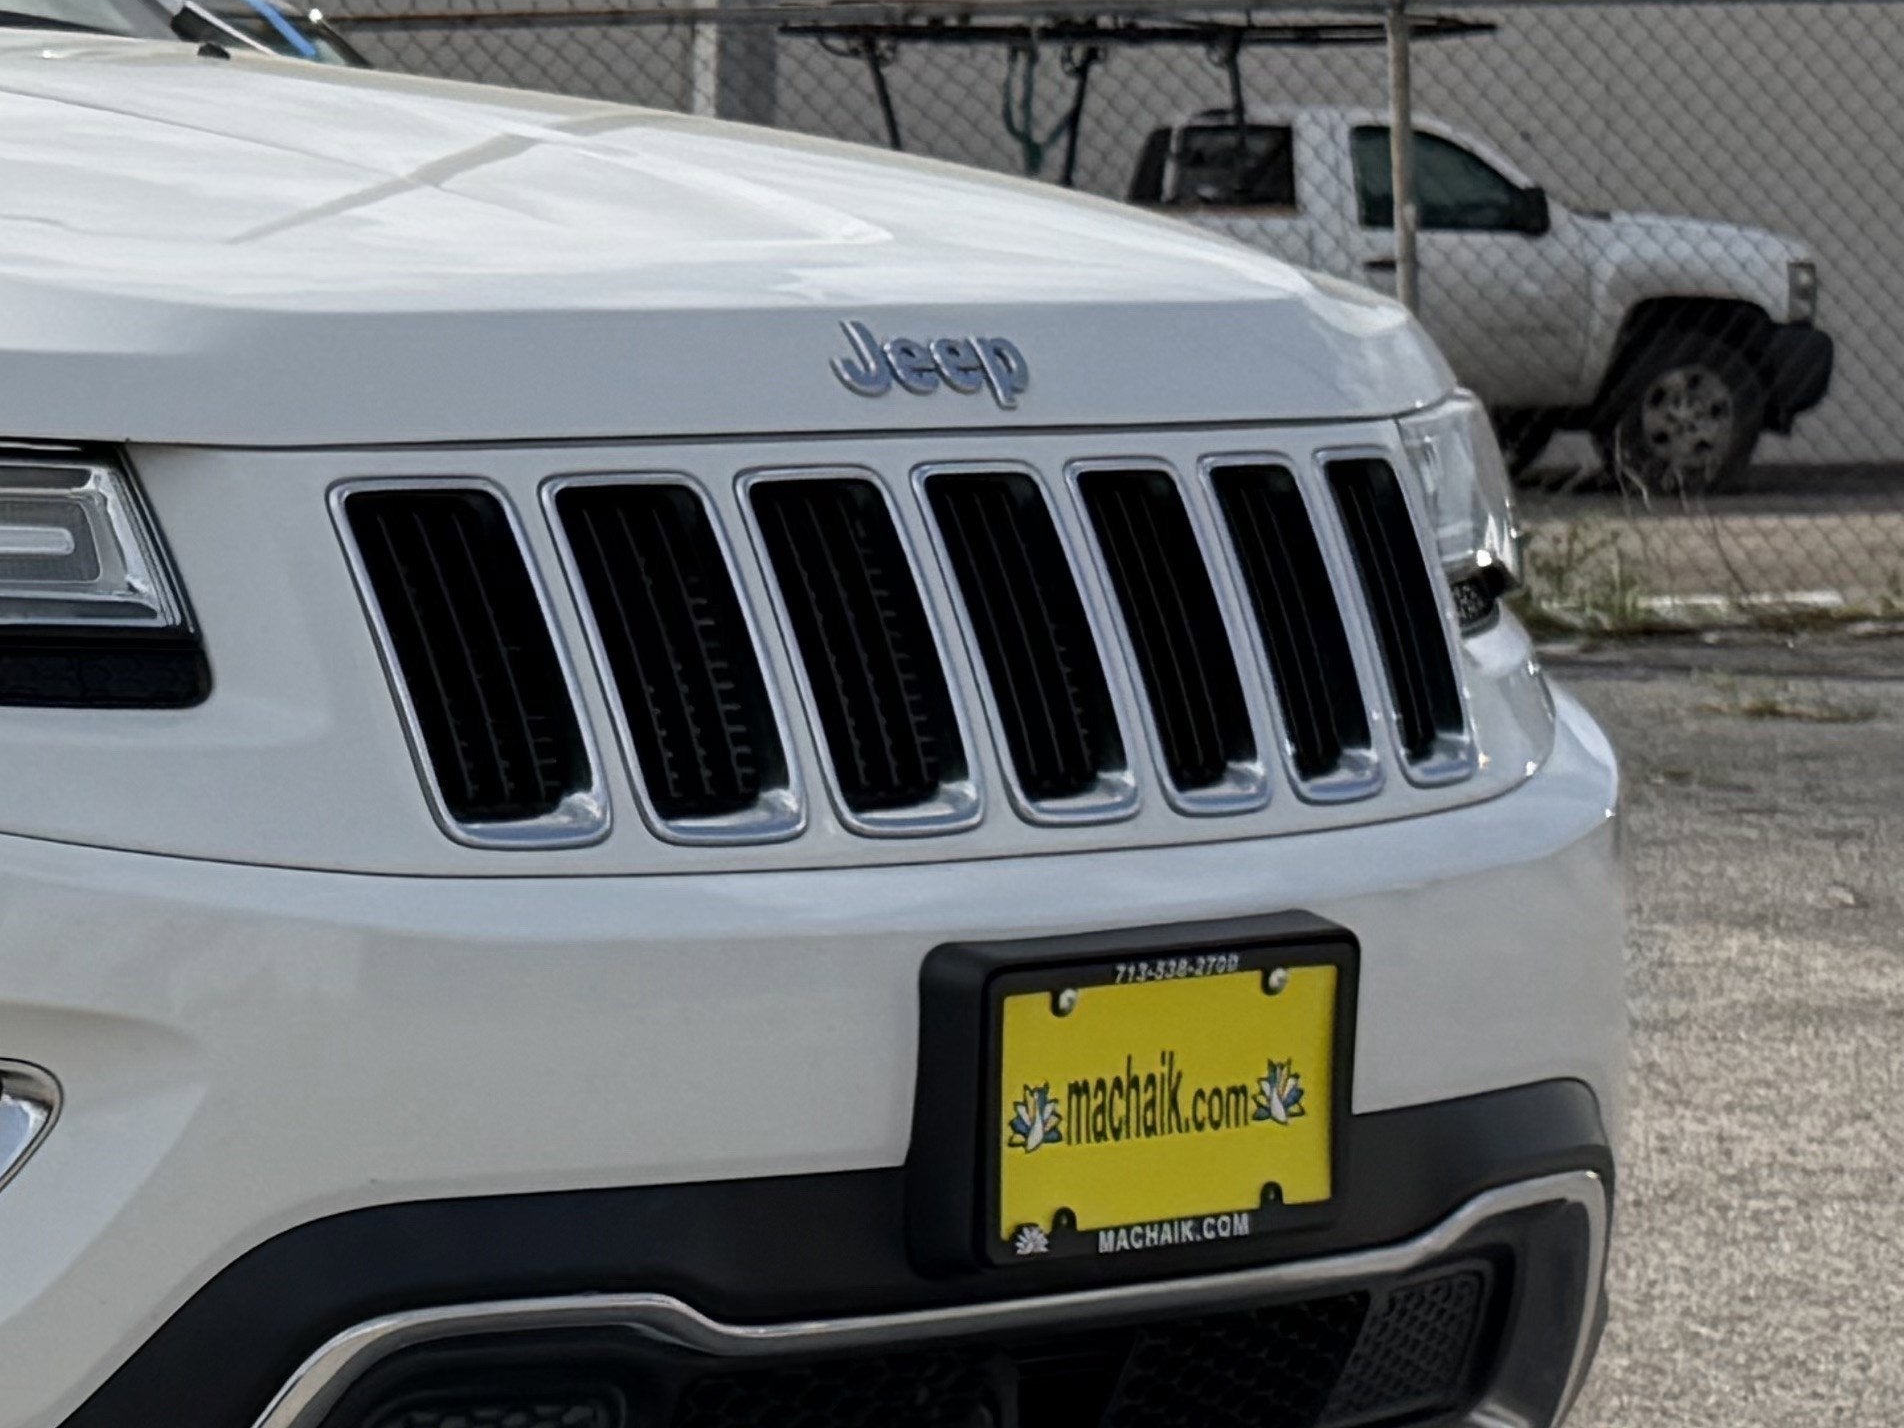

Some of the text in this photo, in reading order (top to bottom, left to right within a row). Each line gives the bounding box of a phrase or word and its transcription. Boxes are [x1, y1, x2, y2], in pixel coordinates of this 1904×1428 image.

[829, 320, 1029, 410] Jeep
[1067, 1050, 1249, 1146] machaik.com
[1098, 1213, 1250, 1254] MACHAIK.COM
